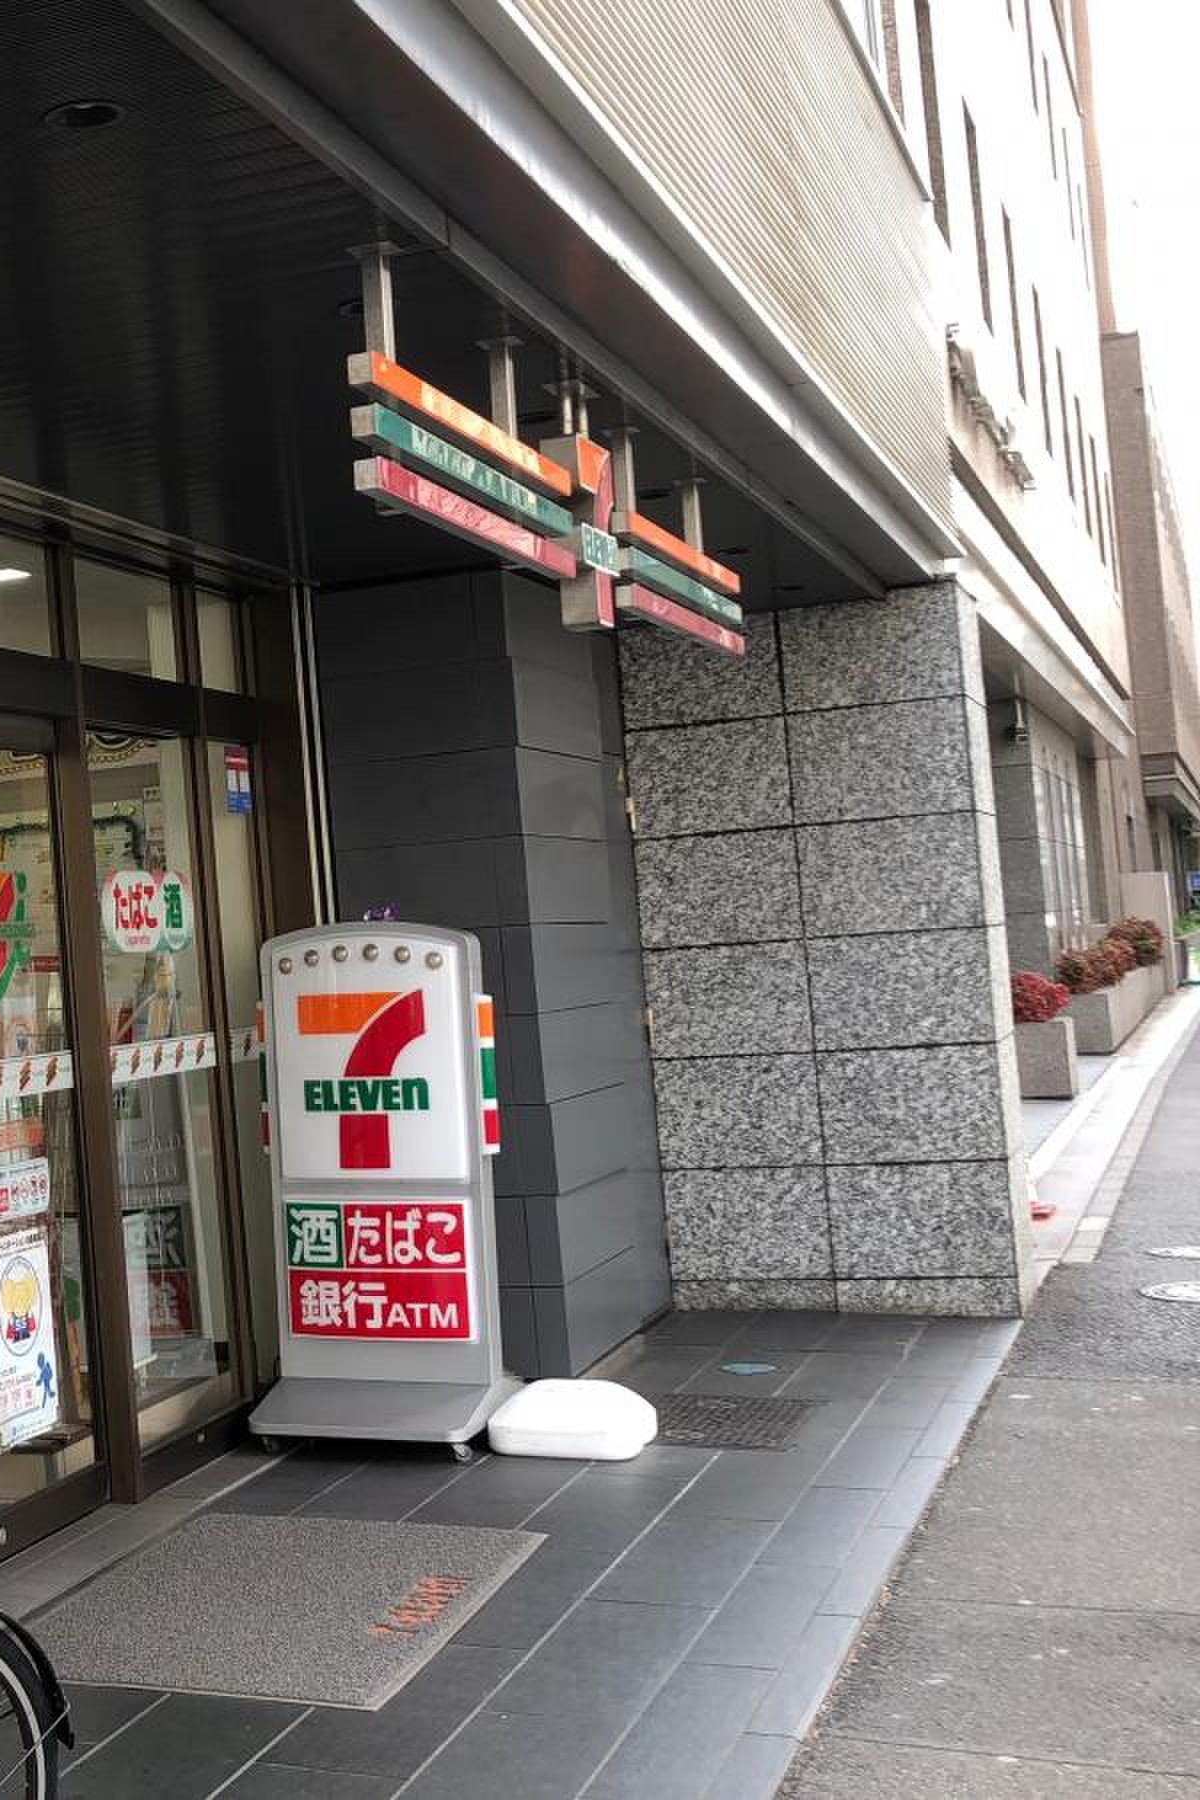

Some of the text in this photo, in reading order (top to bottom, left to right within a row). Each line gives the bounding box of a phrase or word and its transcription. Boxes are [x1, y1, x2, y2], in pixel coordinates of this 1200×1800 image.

[112, 882, 158, 930] たばこ
[297, 989, 426, 1169] 7
[289, 1210, 461, 1267] 酒 たばこ
